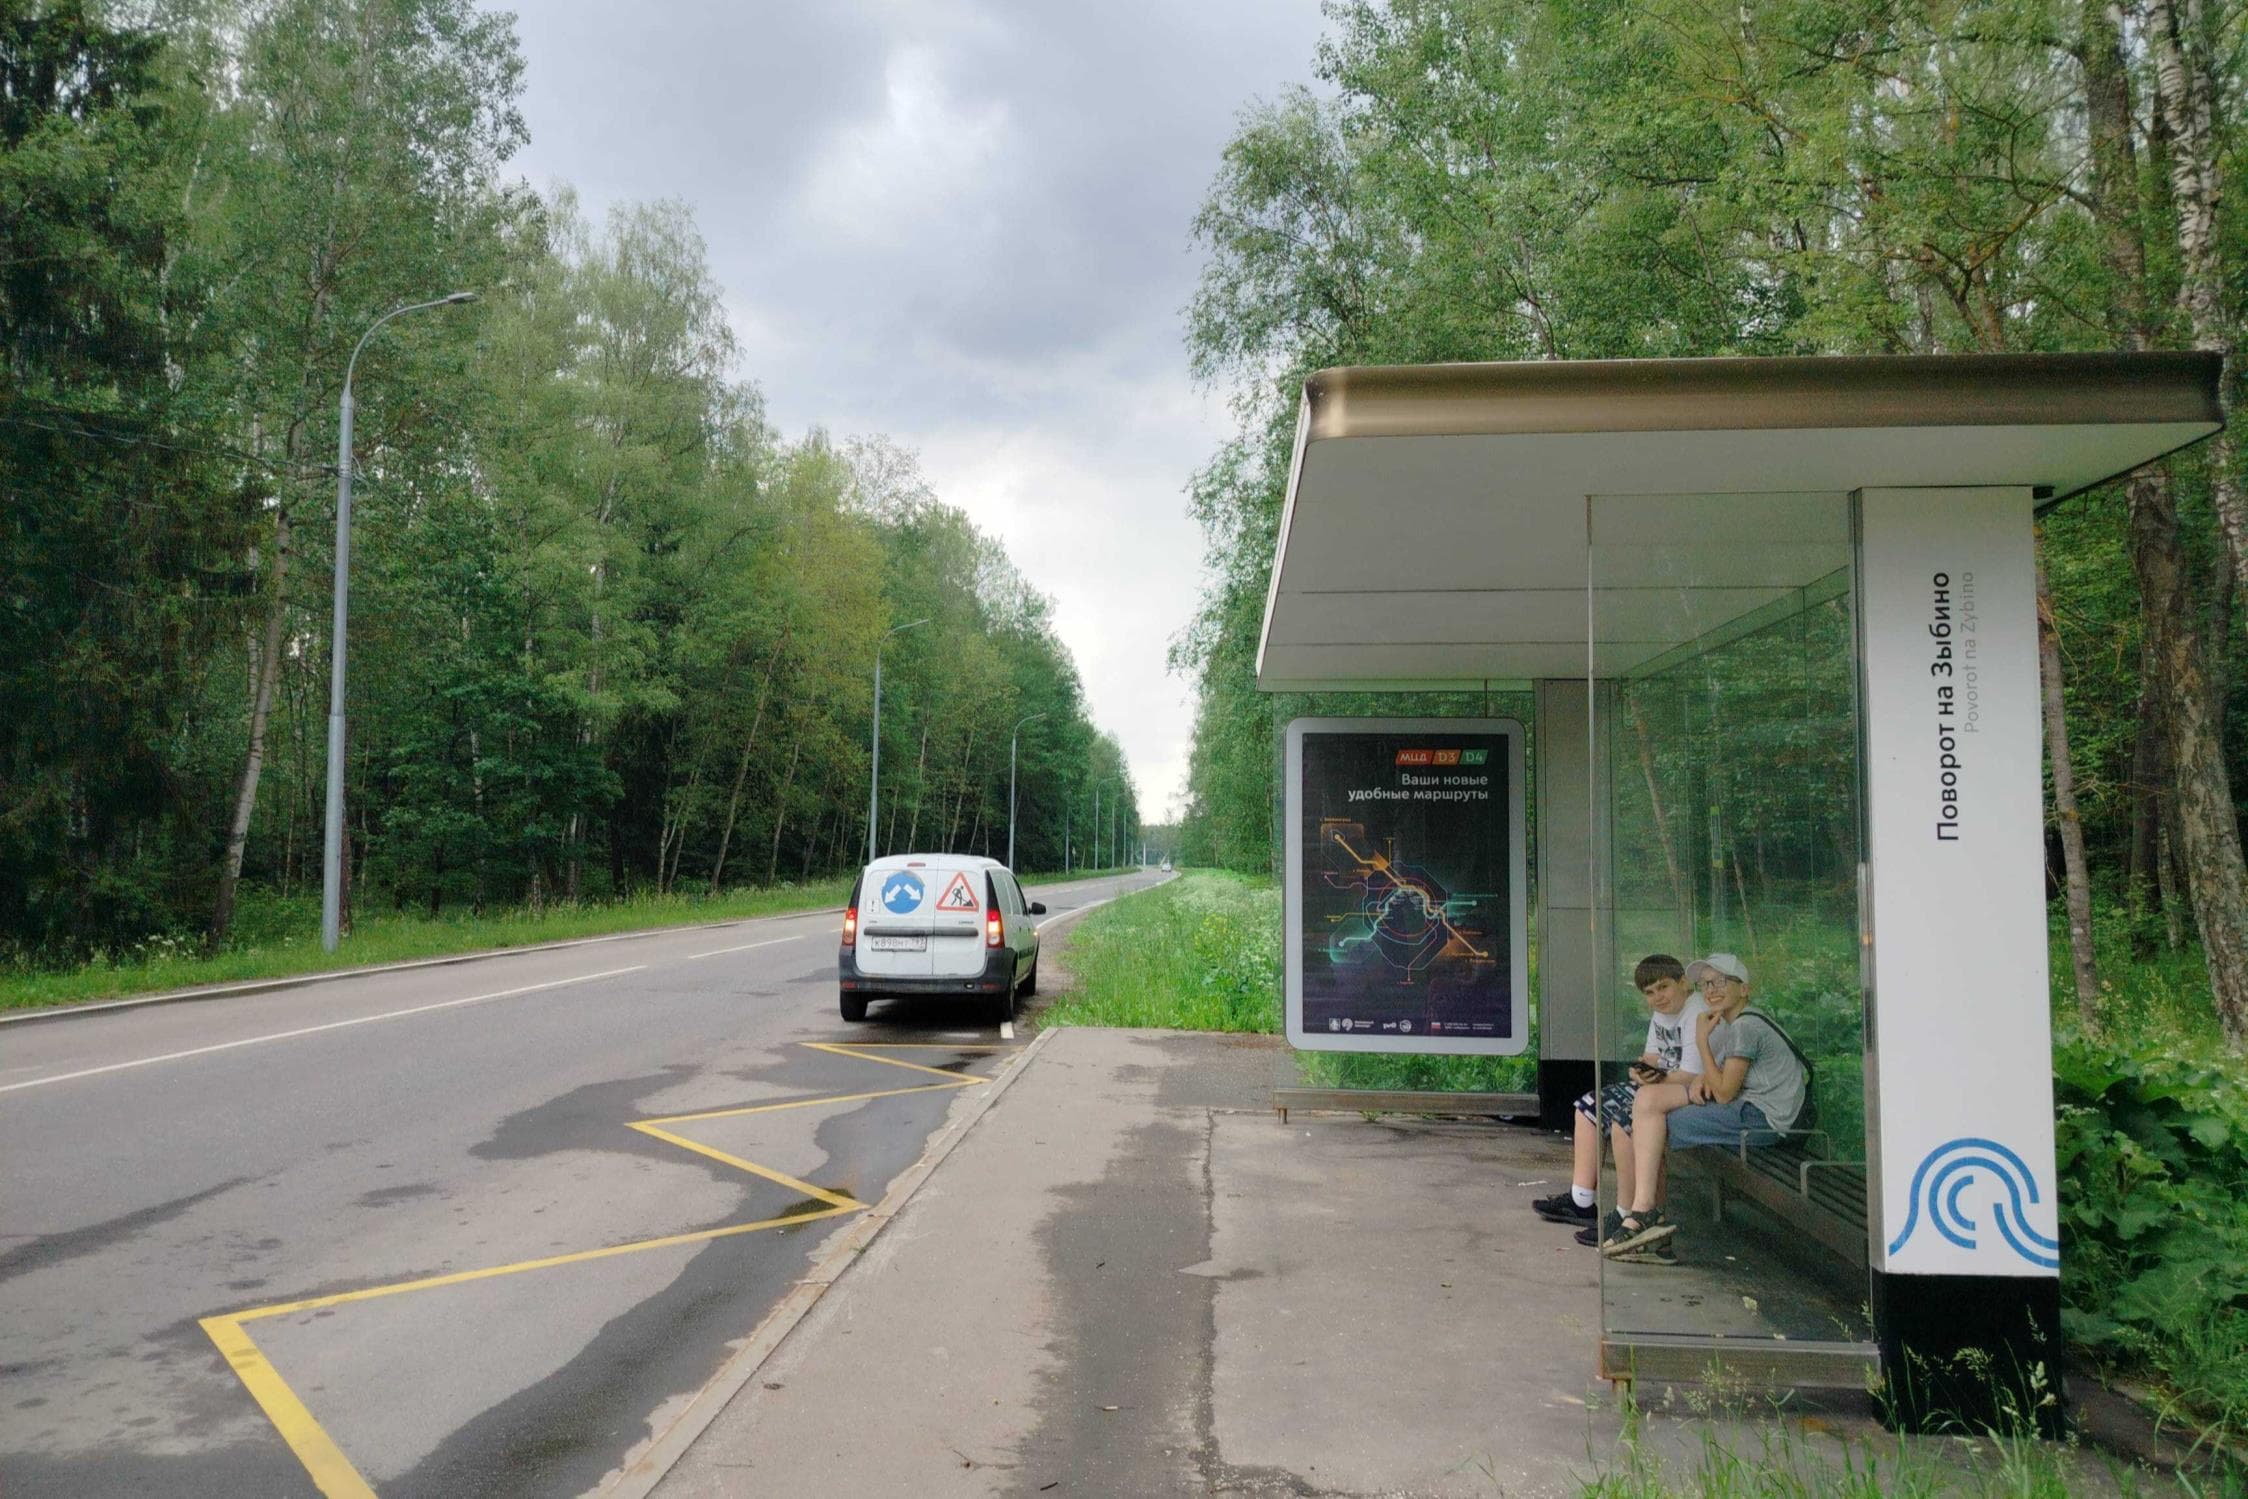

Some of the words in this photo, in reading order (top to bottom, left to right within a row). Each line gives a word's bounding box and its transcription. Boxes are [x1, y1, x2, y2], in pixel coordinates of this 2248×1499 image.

[1960, 571, 1978, 633] Zybino
[1928, 572, 1952, 677] Зыбино
[1965, 639, 1976, 659] na
[1937, 685, 1954, 715] на
[1962, 664, 1979, 733] Povorot
[1400, 752, 1428, 763] МЦД
[1348, 787, 1410, 802] удобные
[1413, 789, 1489, 802] маршруты
[1401, 773, 1440, 786] Ваши
[1443, 775, 1489, 786] новые
[1936, 723, 1961, 841] Поворот
